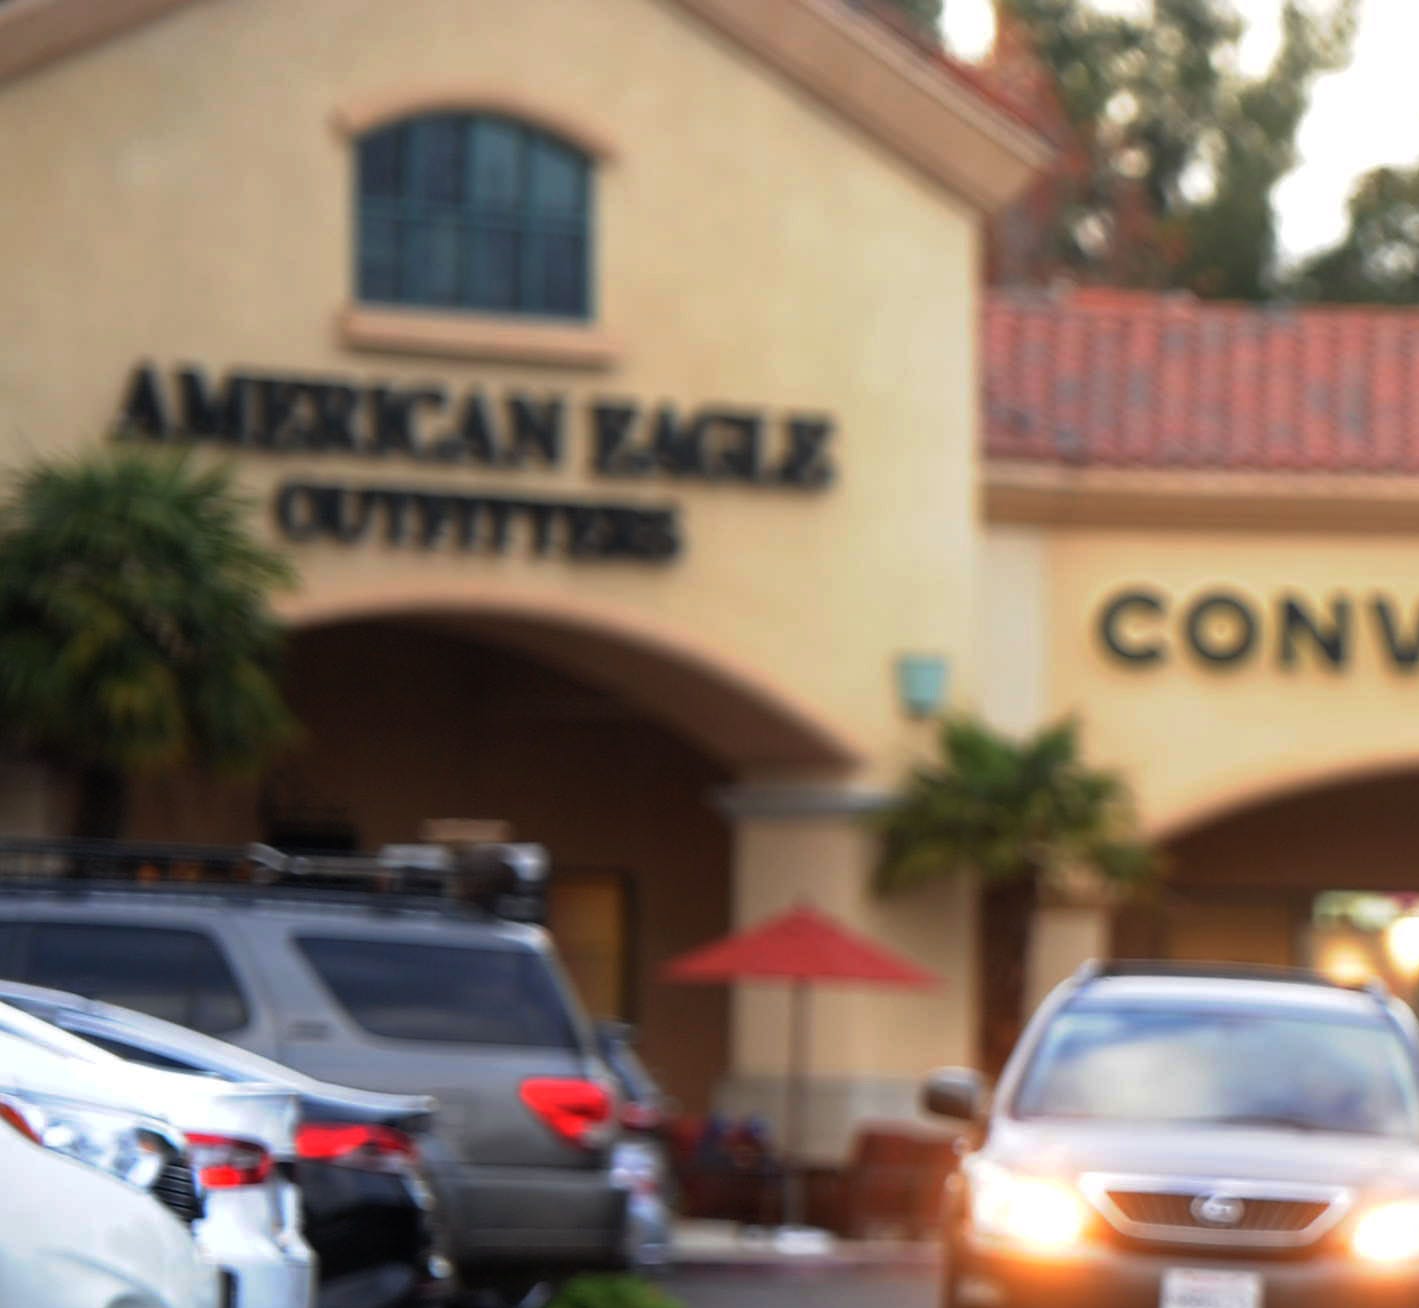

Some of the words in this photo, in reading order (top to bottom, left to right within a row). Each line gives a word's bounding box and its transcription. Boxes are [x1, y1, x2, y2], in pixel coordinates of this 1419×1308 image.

[116, 361, 566, 466] AMERICAN
[588, 398, 836, 489] EAGLE
[276, 481, 682, 562] OUTFITTERS
